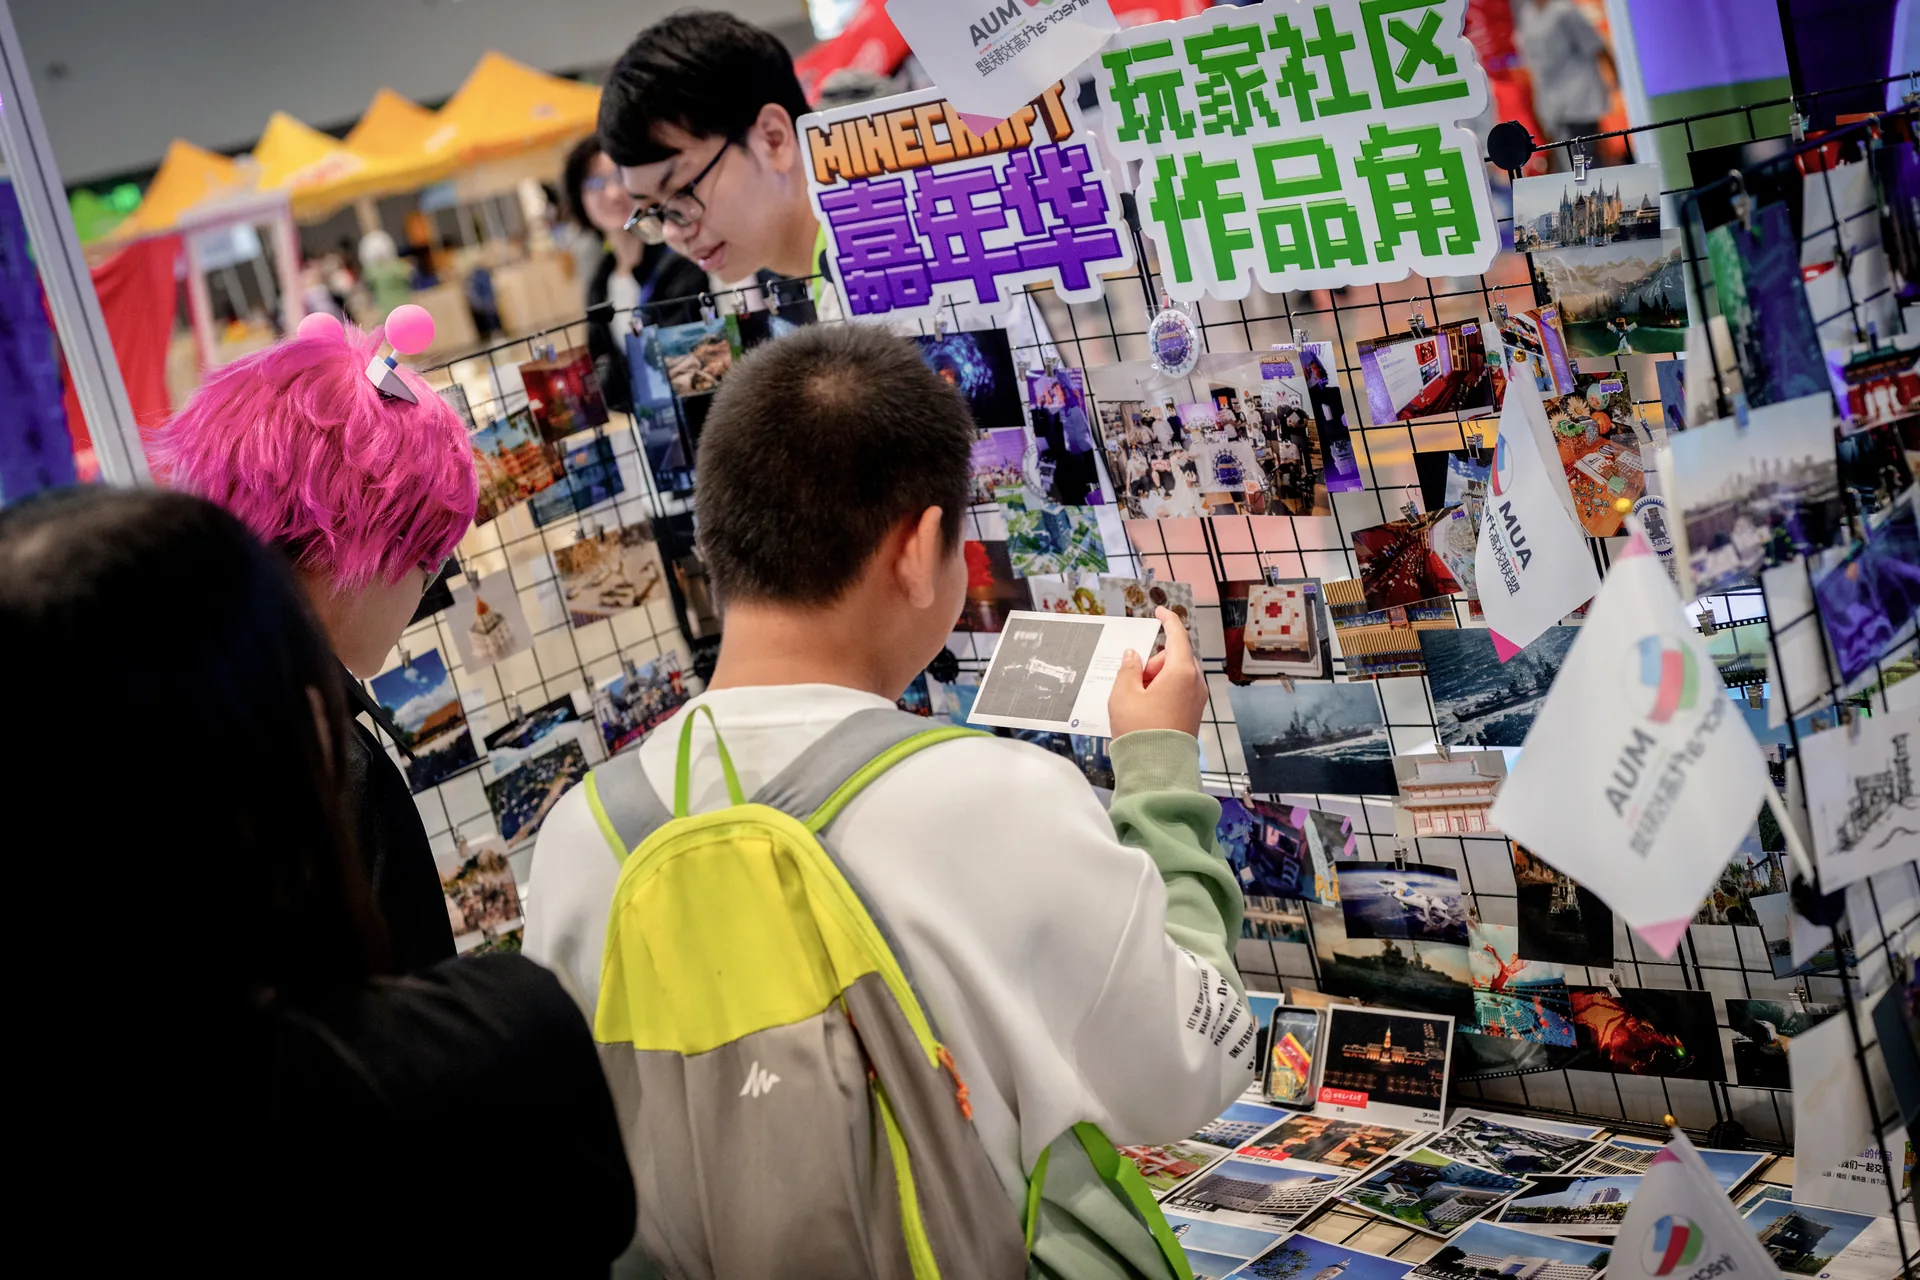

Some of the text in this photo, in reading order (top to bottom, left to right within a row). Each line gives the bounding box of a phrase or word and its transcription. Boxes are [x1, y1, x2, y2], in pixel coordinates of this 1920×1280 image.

[1101, 0, 1470, 144] 玩家社区
[818, 143, 1123, 316] 嘉年华
[1150, 123, 1481, 283] 作品角
[1499, 501, 1532, 571] MUA
[1186, 1016, 1197, 1030] LET
[1192, 1004, 1203, 1018] THE
[1214, 1023, 1231, 1046] PLEASE
[1229, 1005, 1242, 1025] NOTE
[1228, 1045, 1243, 1059] ONE
